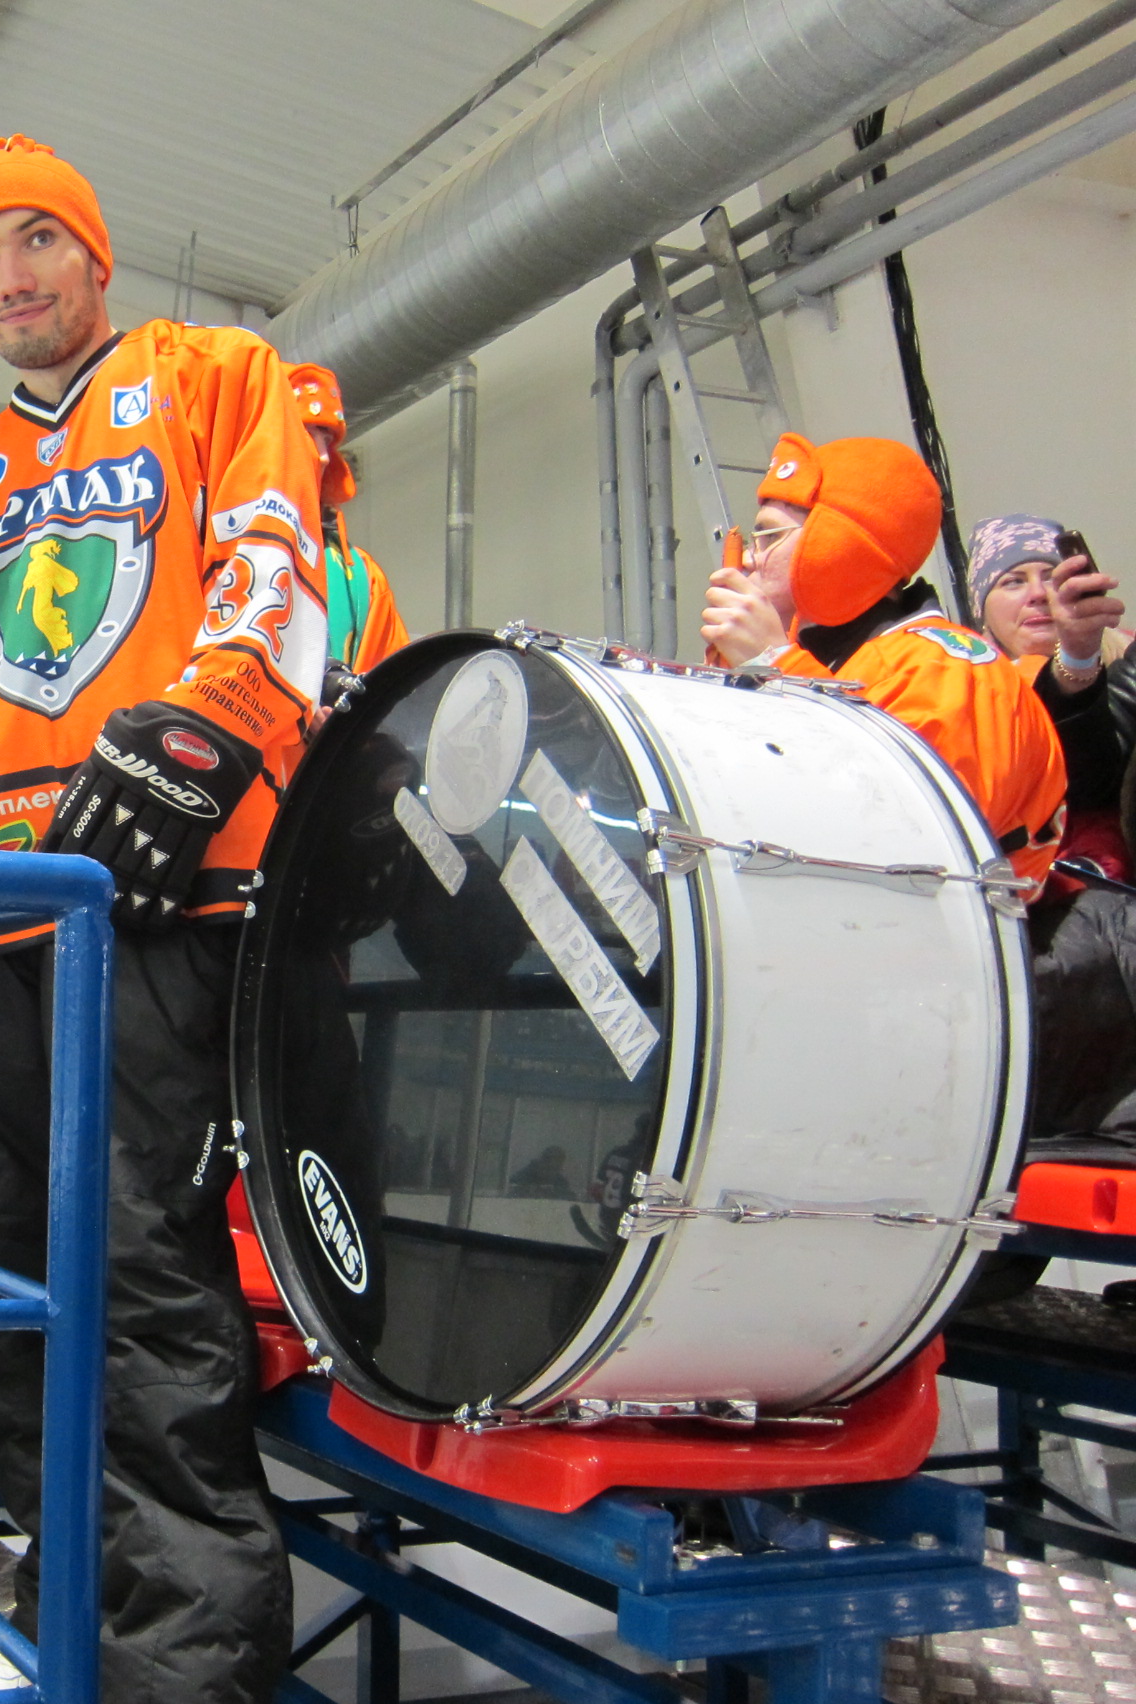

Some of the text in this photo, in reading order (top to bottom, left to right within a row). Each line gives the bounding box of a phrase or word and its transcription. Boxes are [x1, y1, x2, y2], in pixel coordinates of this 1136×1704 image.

[204, 553, 294, 663] 32
[236, 661, 261, 692] ООО
[95, 723, 204, 807] HER-WOOD
[304, 1160, 362, 1276] EVANS
